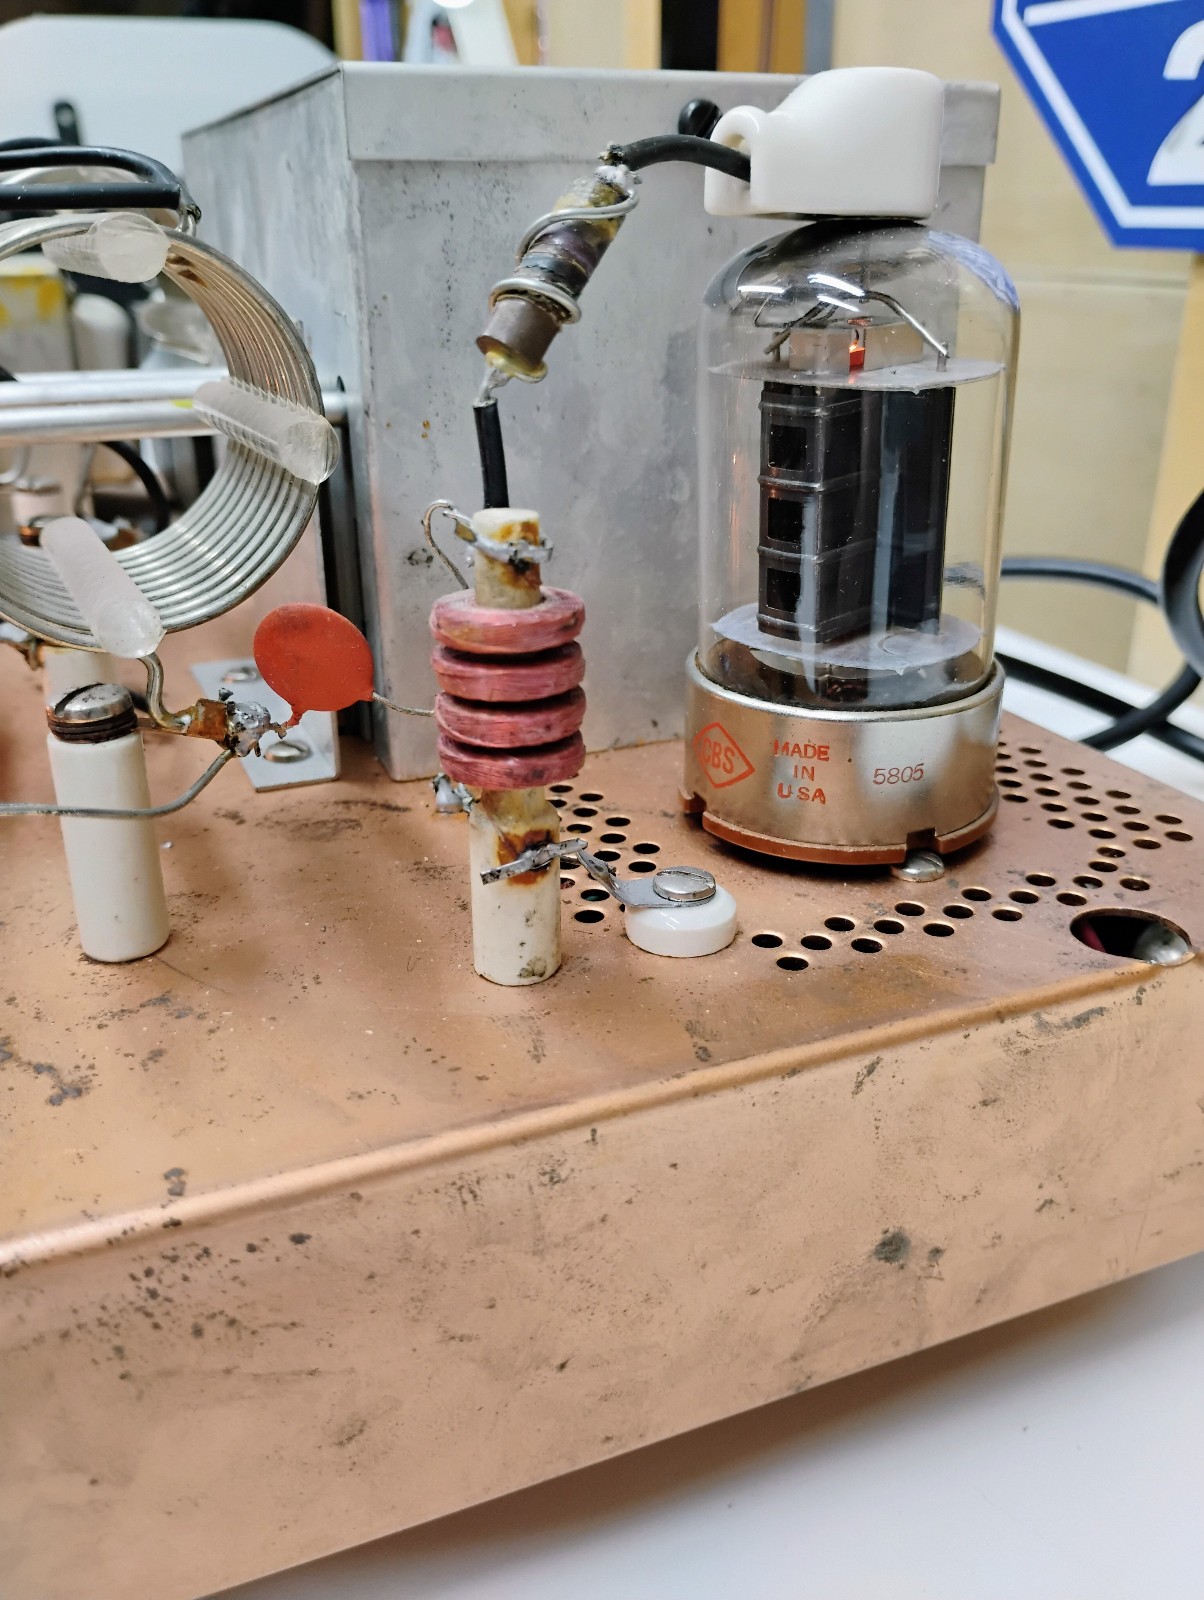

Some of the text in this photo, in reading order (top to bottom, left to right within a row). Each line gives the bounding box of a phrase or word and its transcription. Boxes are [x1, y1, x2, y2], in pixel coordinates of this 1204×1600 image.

[701, 735, 736, 775] CBS
[773, 739, 830, 762] MADE
[793, 764, 815, 782] IN
[872, 763, 925, 785] 5805
[777, 782, 826, 804] USA
